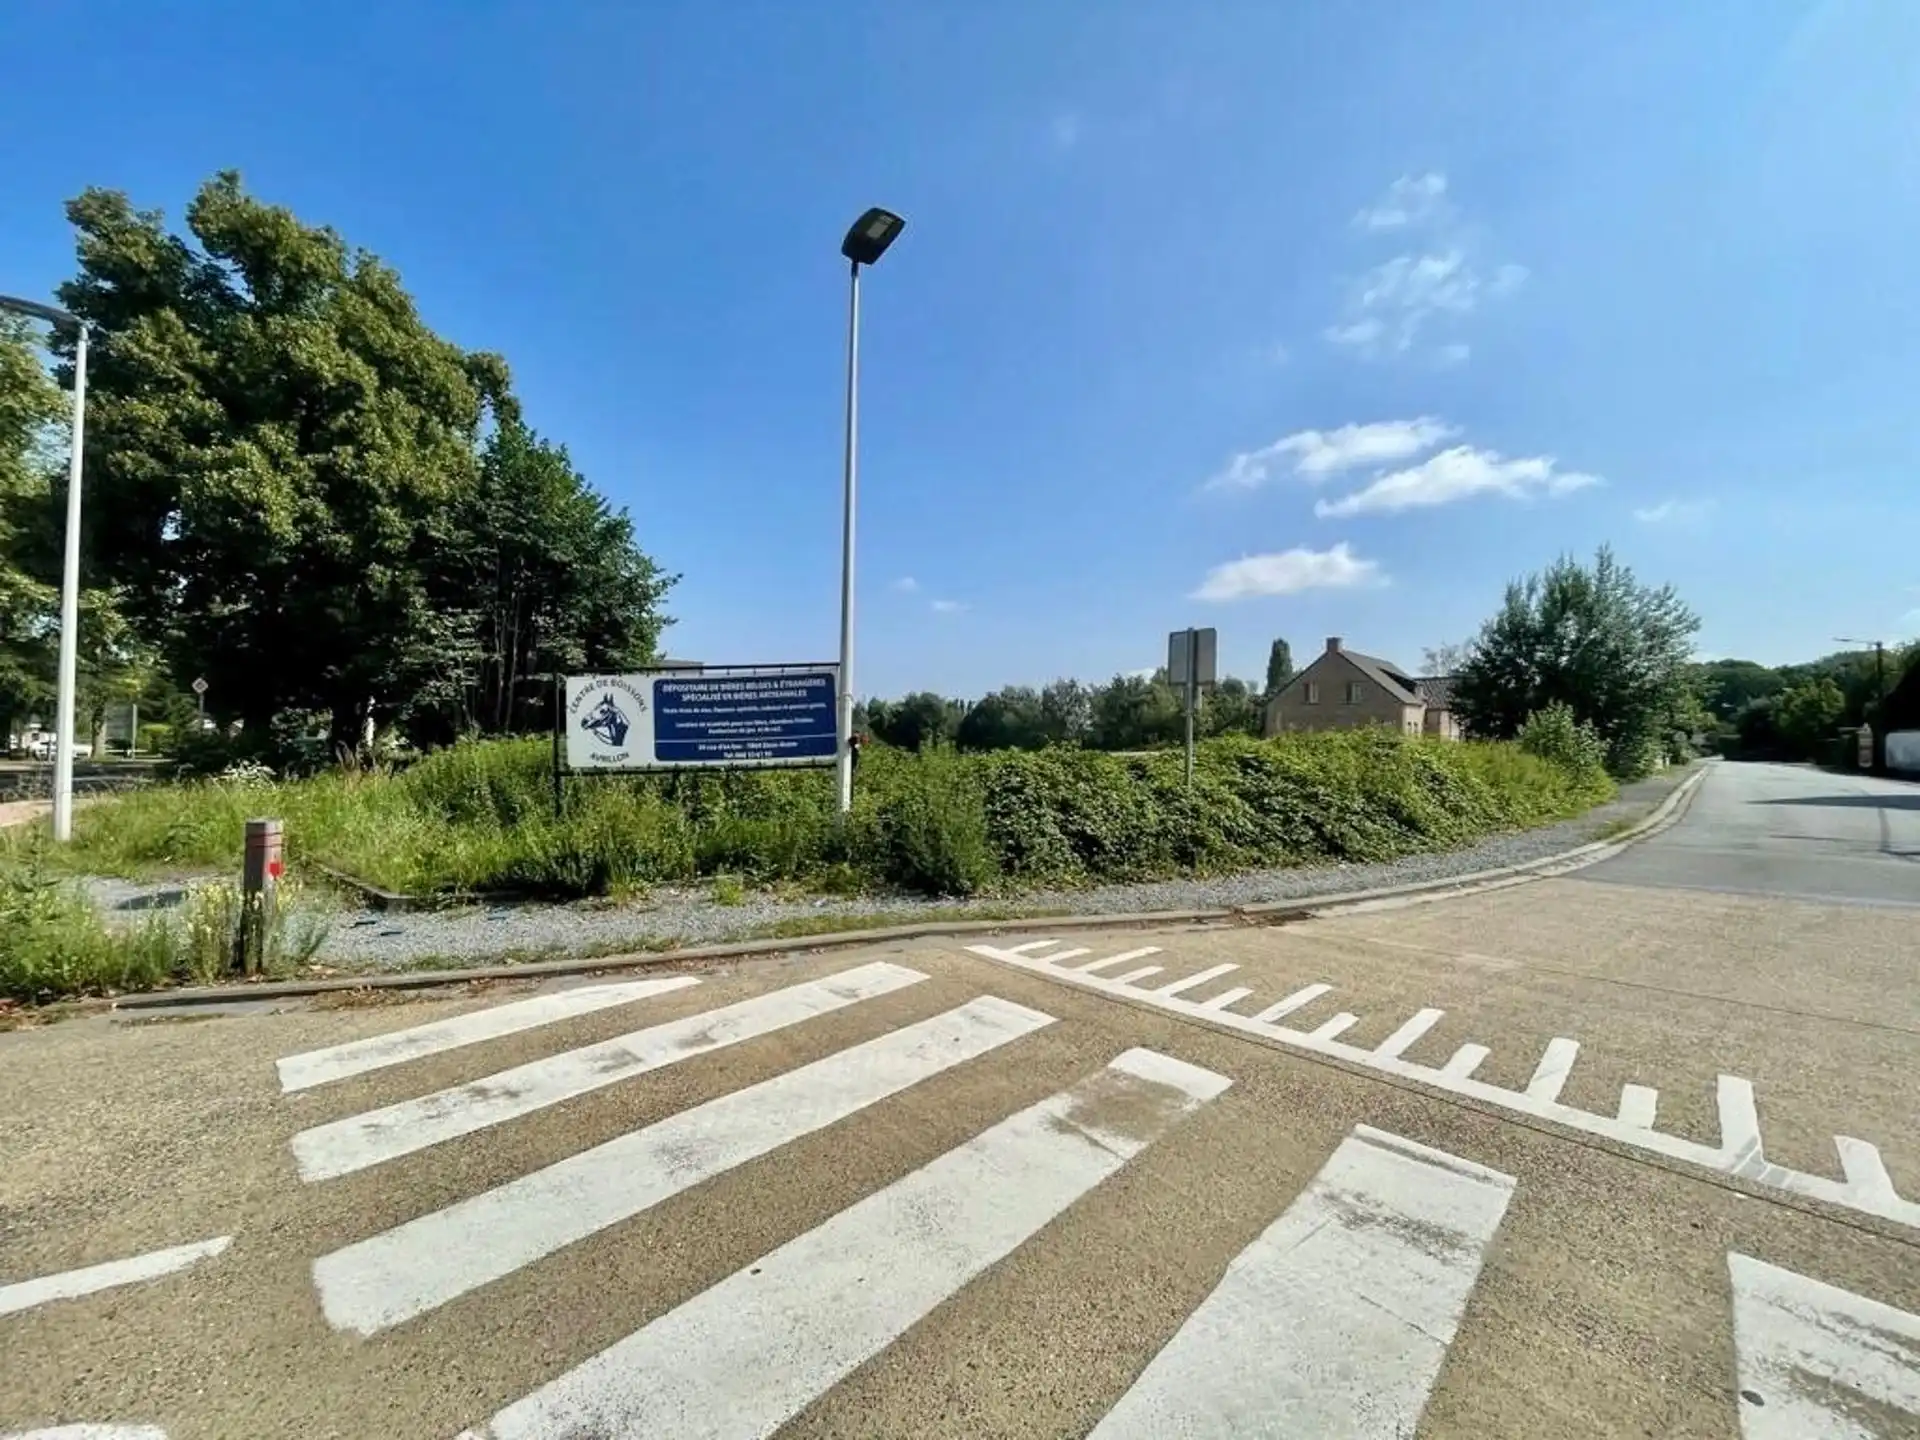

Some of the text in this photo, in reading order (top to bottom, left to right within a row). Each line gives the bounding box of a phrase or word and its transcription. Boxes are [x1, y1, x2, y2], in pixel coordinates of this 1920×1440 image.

[570, 679, 648, 714] CENTRE DE BOISSONS
